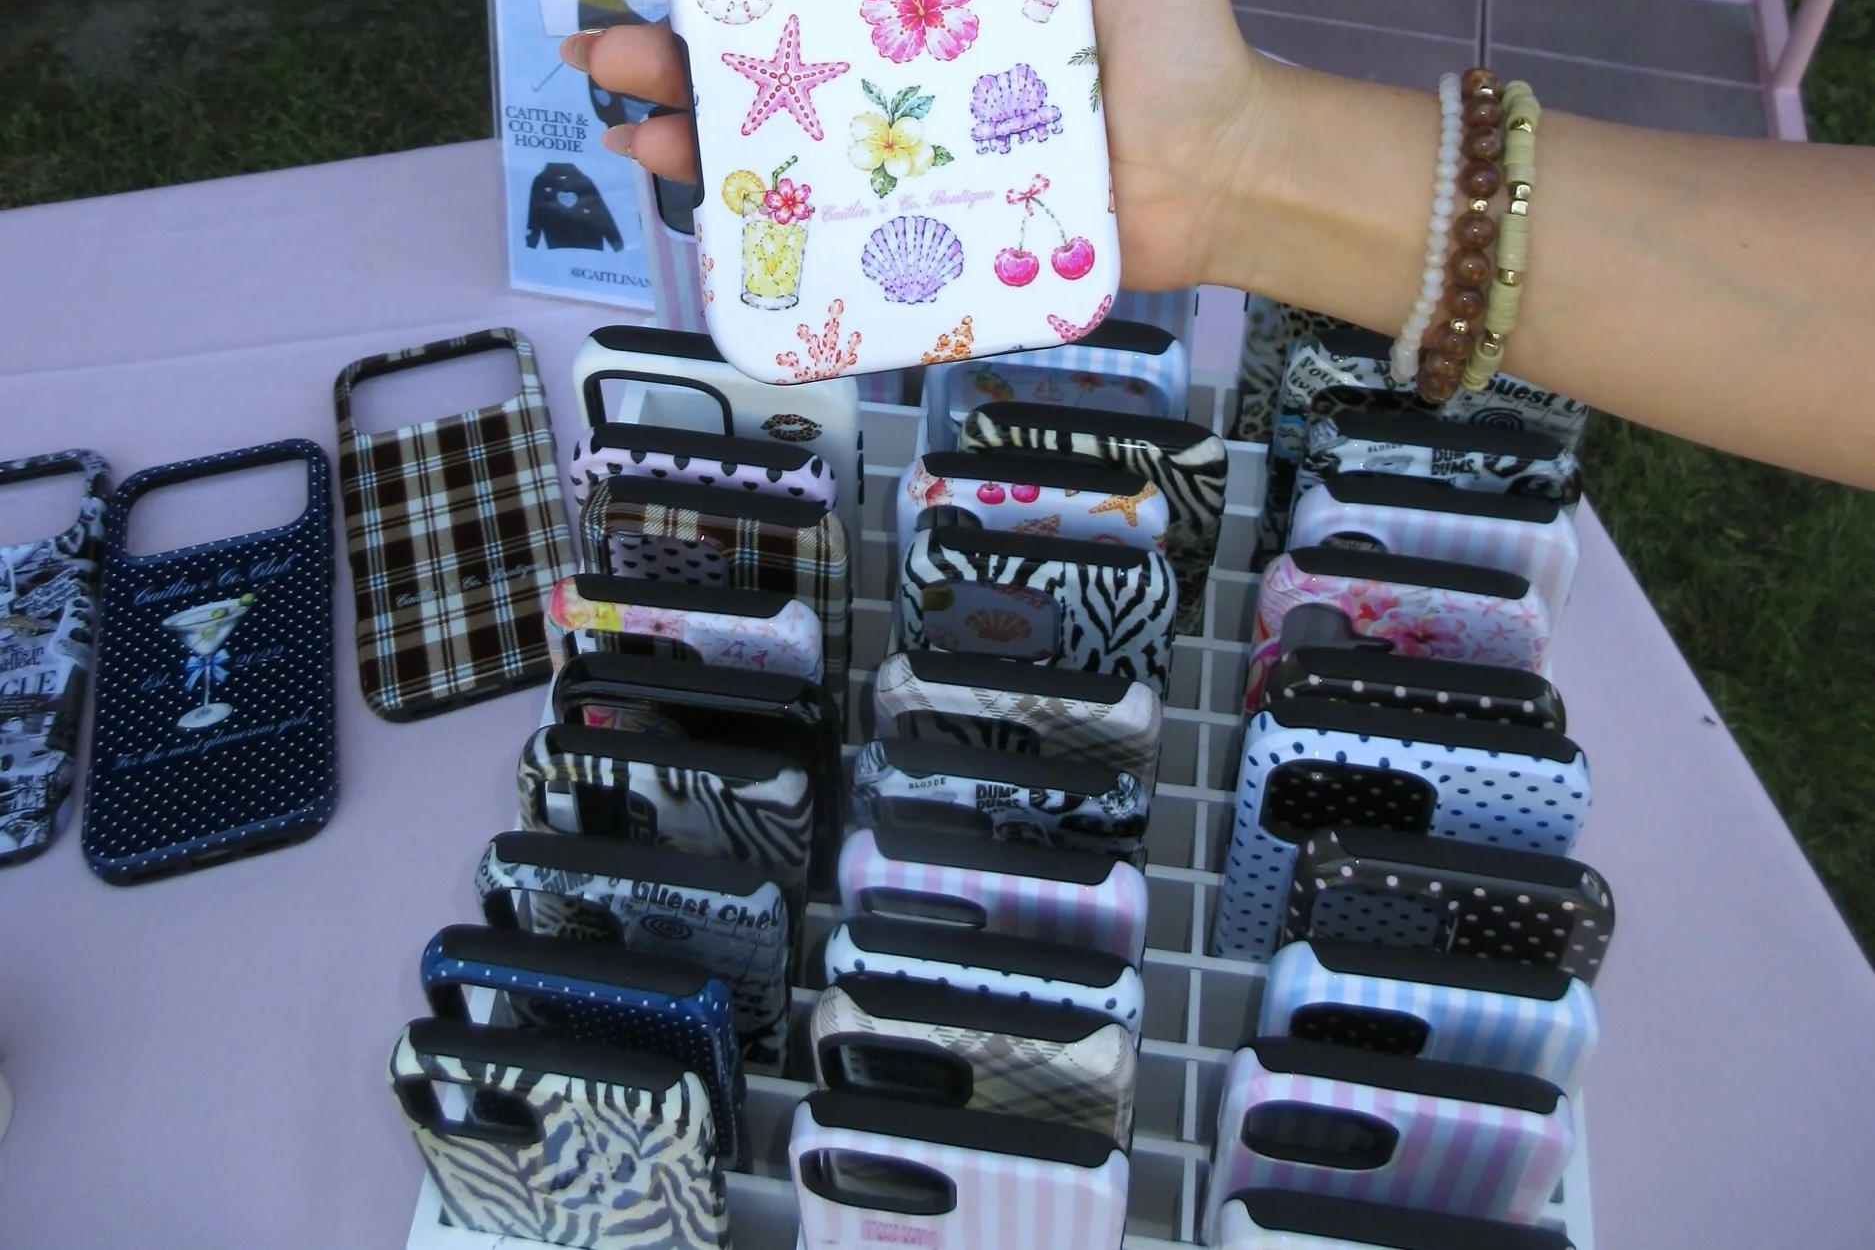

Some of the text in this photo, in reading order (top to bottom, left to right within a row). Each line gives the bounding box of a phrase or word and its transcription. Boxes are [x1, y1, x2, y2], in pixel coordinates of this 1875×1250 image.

[505, 105, 589, 127] CAITLIN &
[509, 120, 587, 141] CO. CLUB
[514, 134, 584, 154] HOODIE
[821, 199, 872, 223] Caitlin
[927, 189, 995, 209] Boutique
[133, 576, 197, 606] Caitlin
[250, 554, 297, 579] Club
[235, 645, 284, 667] 2022
[112, 708, 311, 771] For the most glamorous girls
[909, 777, 946, 790] BLONDE
[631, 880, 711, 917] Guest
